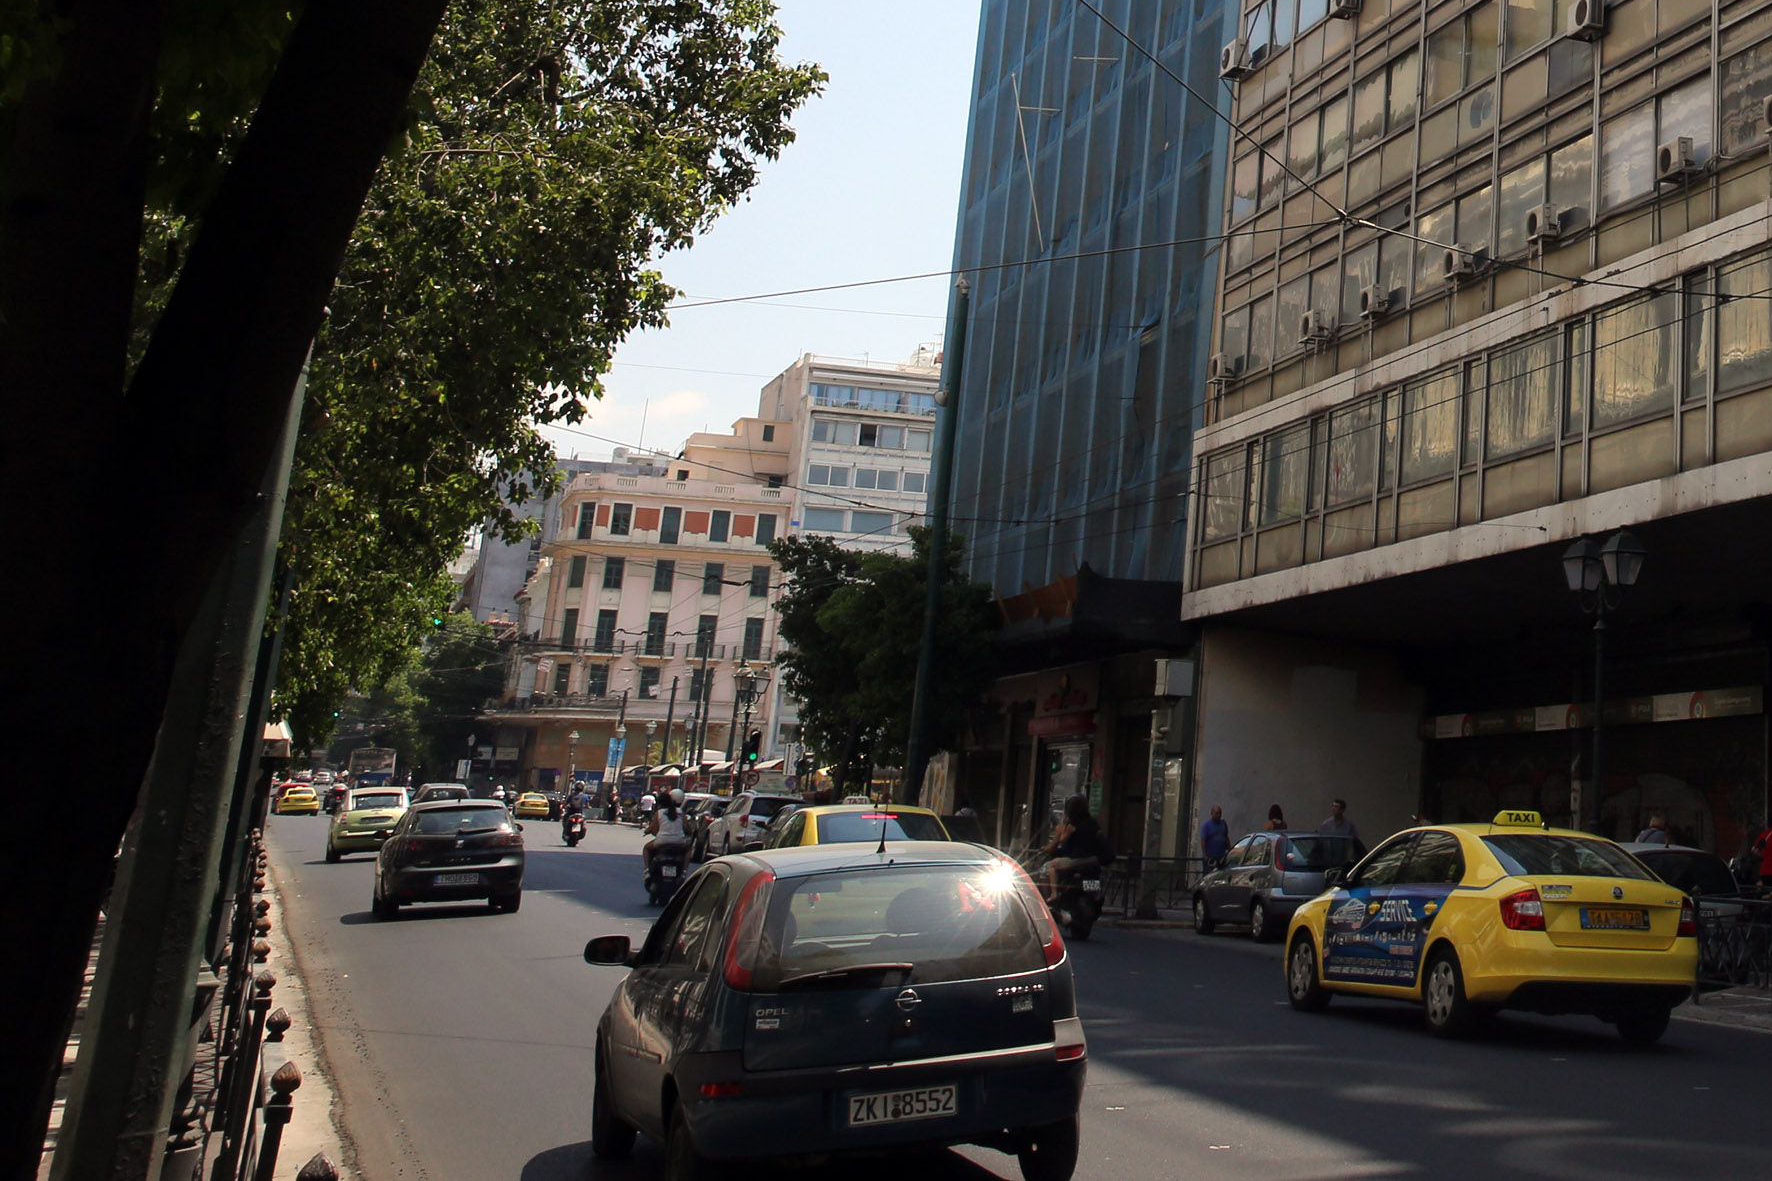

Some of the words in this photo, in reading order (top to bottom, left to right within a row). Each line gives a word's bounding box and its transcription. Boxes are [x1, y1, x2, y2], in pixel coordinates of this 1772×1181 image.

[1507, 813, 1535, 823] TAXI
[1380, 899, 1417, 922] SERVICE
[755, 1007, 789, 1017] OPEL
[902, 1087, 954, 1116] 8552
